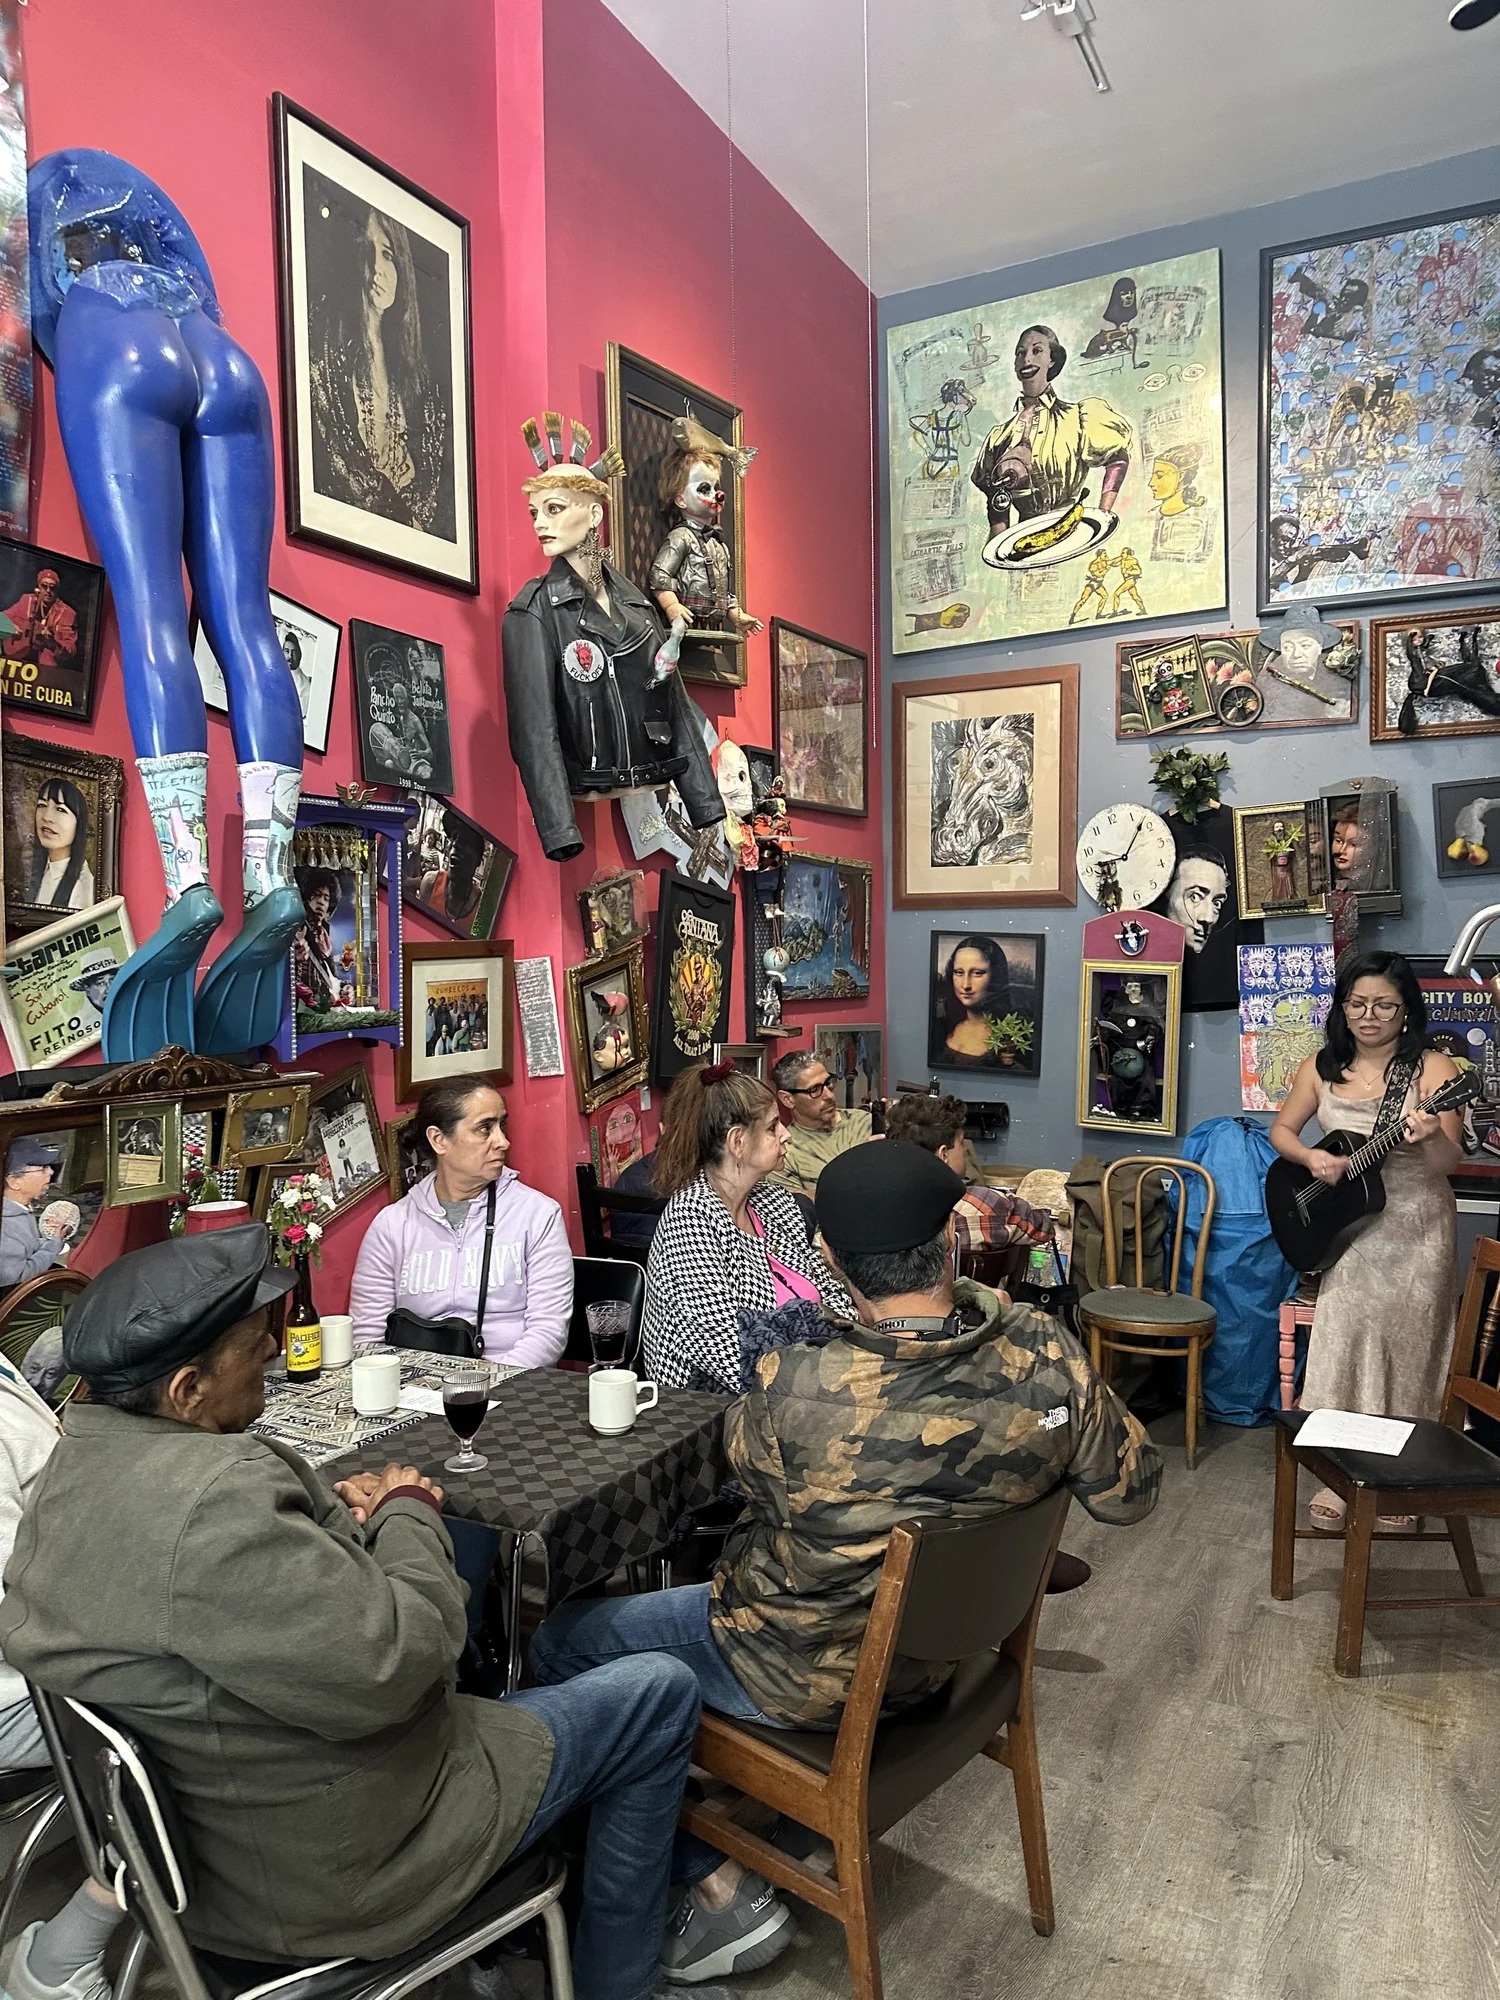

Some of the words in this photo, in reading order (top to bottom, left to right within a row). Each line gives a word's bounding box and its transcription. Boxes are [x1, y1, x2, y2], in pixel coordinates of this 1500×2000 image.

[570, 667, 590, 681] FUCK
[591, 664, 603, 679] OFF
[13, 681, 32, 699] DE
[36, 685, 73, 707] CUBA
[370, 685, 396, 709] Pancho
[369, 703, 396, 725] Quinto
[1107, 813, 1118, 825] 12
[1092, 825, 1101, 837] 11
[1146, 821, 1154, 832] 2
[1156, 837, 1165, 849] 3
[1083, 846, 1094, 858] 10
[1157, 858, 1166, 868] 4
[1085, 866, 1094, 877] 9
[1149, 879, 1158, 890] 5
[1132, 889, 1141, 901] 6
[1421, 991, 1456, 1004] CITY
[1462, 991, 1493, 1005] BOY
[29, 1016, 81, 1052] FITO
[43, 1020, 101, 1056] REINOSO
[1433, 1034, 1454, 1042] SUAVE
[409, 1249, 453, 1295] OLD
